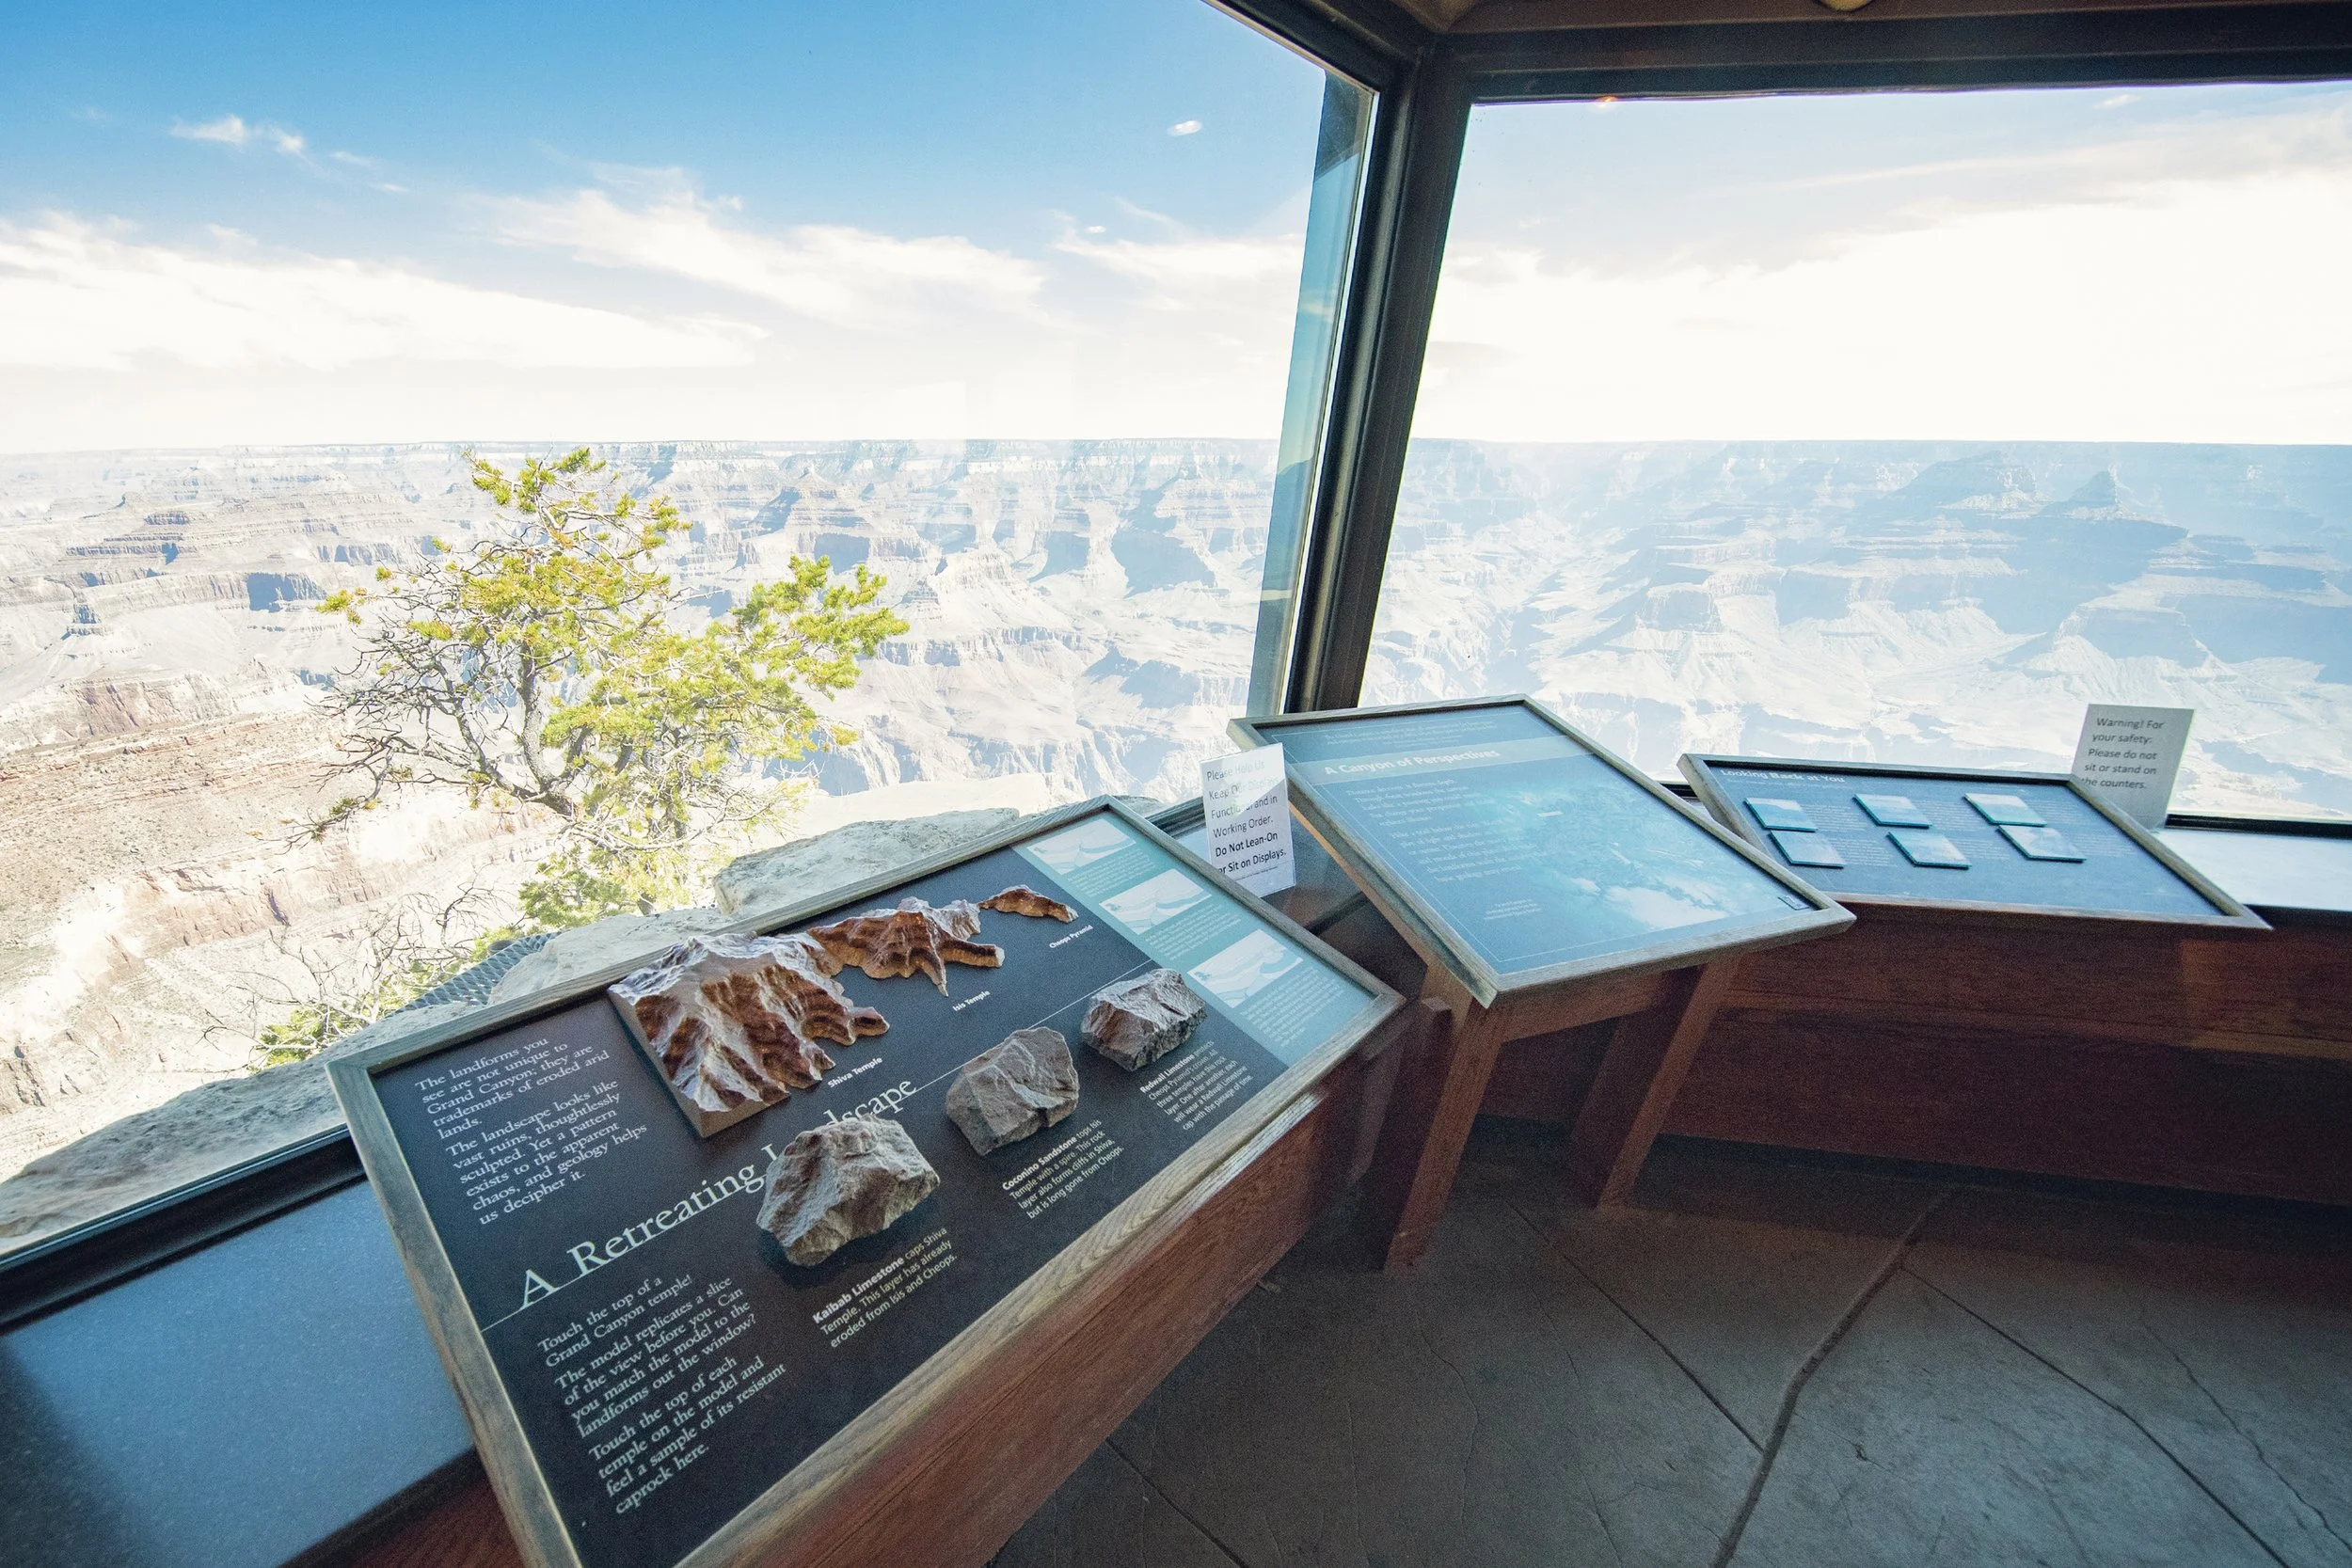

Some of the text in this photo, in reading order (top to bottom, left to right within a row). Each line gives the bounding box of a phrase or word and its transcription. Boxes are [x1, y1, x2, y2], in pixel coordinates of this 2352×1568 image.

[2089, 749, 2157, 760] Please do not
[2092, 734, 2115, 742] your
[2096, 718, 2164, 730] Warning! For
[1206, 768, 1232, 781] Please
[1234, 762, 1253, 774] Help
[1209, 789, 1229, 800] Keep
[1324, 750, 1501, 775] A Canyon of Perspectives
[1720, 769, 1769, 779] Looking
[1769, 771, 1804, 781] Back
[2100, 779, 2147, 788] counters.
[2143, 767, 2156, 775] on
[1212, 816, 1274, 838] Working Order.
[1255, 796, 1278, 809] and in
[1216, 832, 1278, 857] Do Not Lean-On
[1229, 862, 1239, 873] Sit
[1253, 848, 1286, 864] Displays.
[1069, 924, 1093, 939] Pyramid
[952, 990, 991, 1012] Isis Temple
[414, 1038, 548, 1090] The landforms you
[422, 1043, 568, 1103] see are not unique to
[427, 1046, 594, 1114] Grand Canyon; they are
[433, 1050, 610, 1127] trademarks of eroded arid
[828, 1057, 882, 1088] Shiva Temple
[437, 1118, 483, 1139] lands.
[445, 1081, 618, 1156] The landscape looks like
[453, 1092, 620, 1169] vast ruins, thoughtlessly
[460, 1148, 526, 1184] sculpted.
[528, 1138, 553, 1151] Yet
[569, 1110, 617, 1137] pattern
[466, 1123, 620, 1196] exists to the apparent
[472, 1125, 647, 1211] chaos, and geology helps
[1002, 1120, 1102, 1190] Coconino Sandstone tops Isis
[479, 1171, 585, 1225] us decipher it.
[519, 1269, 562, 1310] A
[566, 1164, 765, 1277] Retreating
[812, 1227, 947, 1323] Kaibab Limestone caps Shiva
[820, 1240, 952, 1335] Temple. This layer has already
[831, 1254, 957, 1348] eroded from Isis and Cheops.
[537, 1277, 662, 1352] Touch the top of a
[546, 1274, 692, 1367] Grand Canyon temple!
[554, 1277, 732, 1389] The model replicates a slice
[564, 1289, 743, 1405] of the view before you. Can
[571, 1302, 750, 1424] you match the model to the
[577, 1313, 756, 1438] landforms out the window?
[588, 1357, 738, 1461] Touch the top of each
[598, 1355, 764, 1479] temple on the model and
[606, 1364, 787, 1497] feel a sample of its resistant
[616, 1444, 709, 1514] caprock here.
